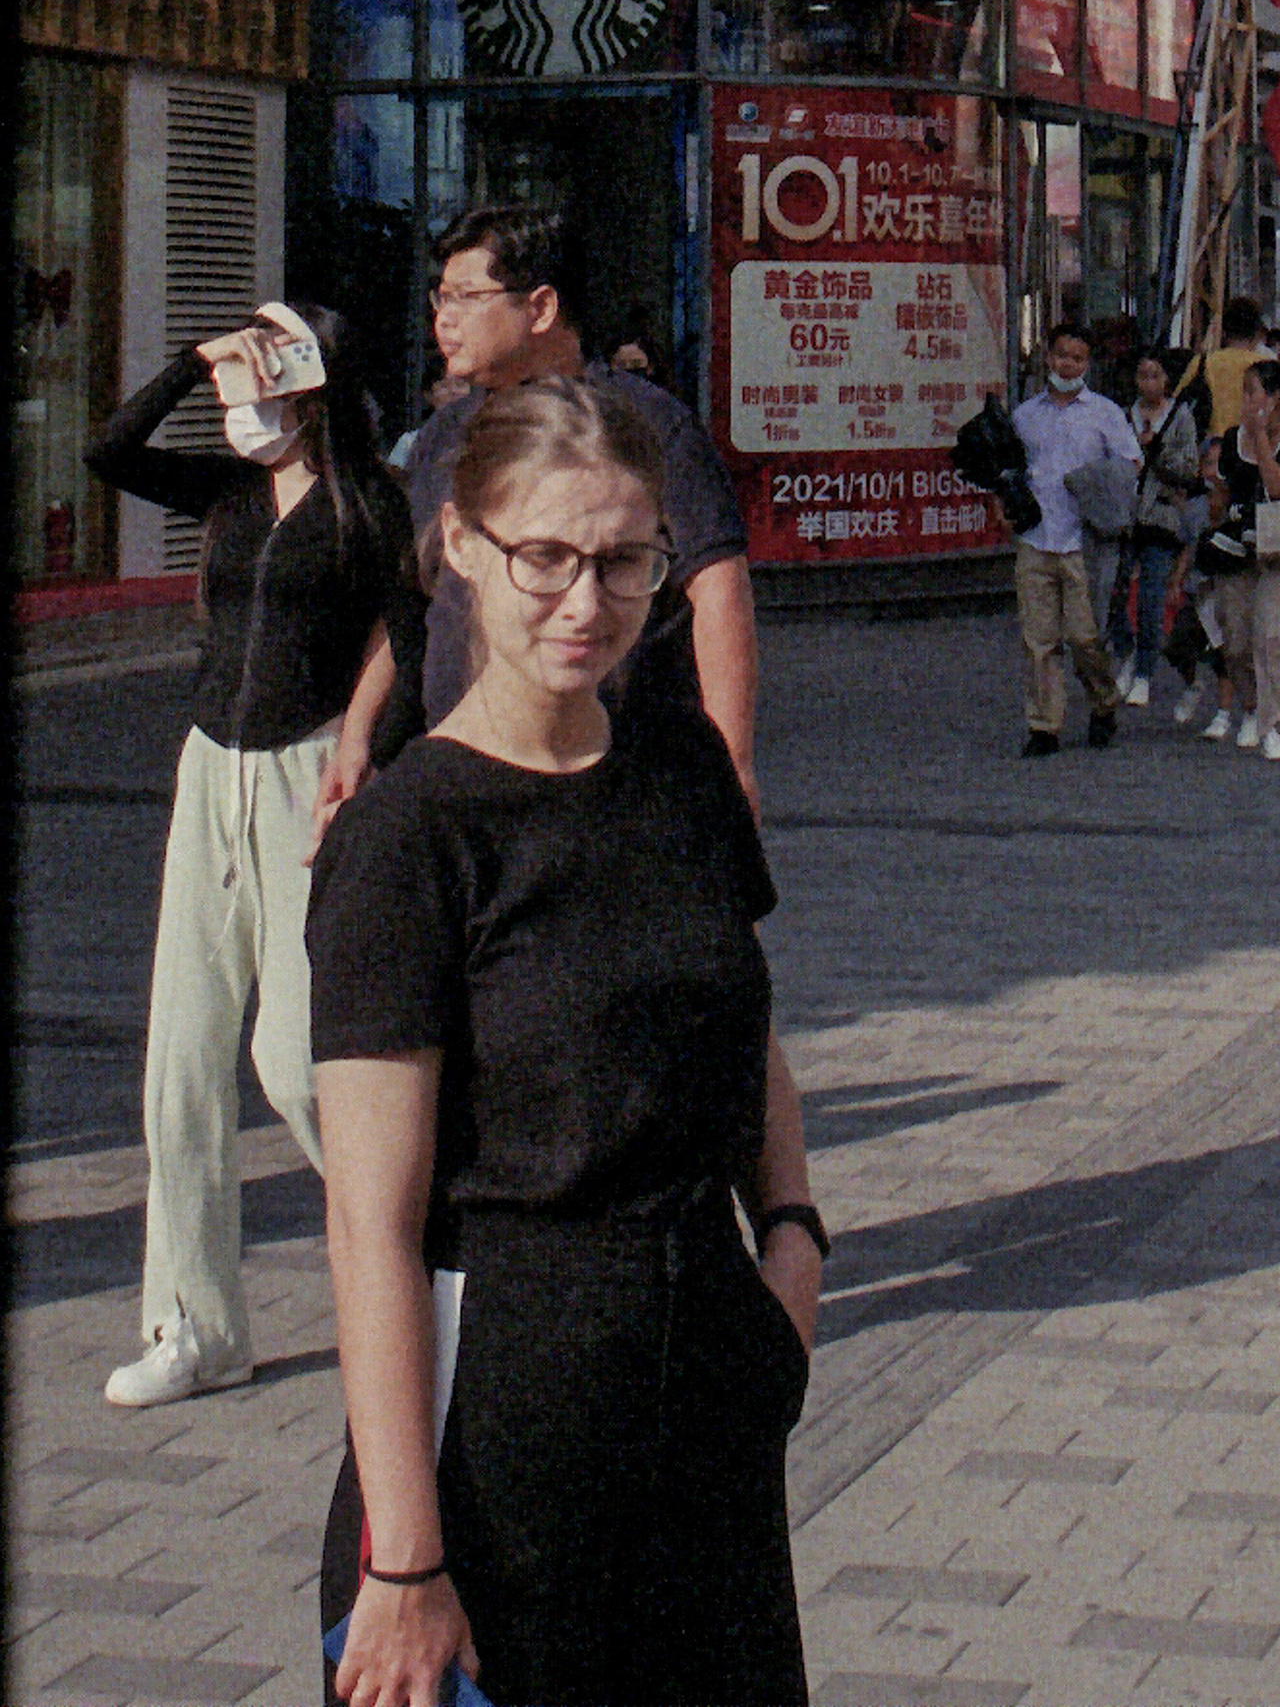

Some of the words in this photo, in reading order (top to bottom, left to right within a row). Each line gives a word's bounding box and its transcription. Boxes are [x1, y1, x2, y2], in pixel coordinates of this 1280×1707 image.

[764, 270, 873, 300] 黄金饰品
[915, 273, 952, 301] 钻石
[789, 324, 850, 351] 60元
[741, 385, 819, 405] 时尚男装
[838, 384, 904, 404] 时尚女装
[772, 472, 905, 503] 2021/10/1
[797, 510, 900, 541] 举国欢庆
